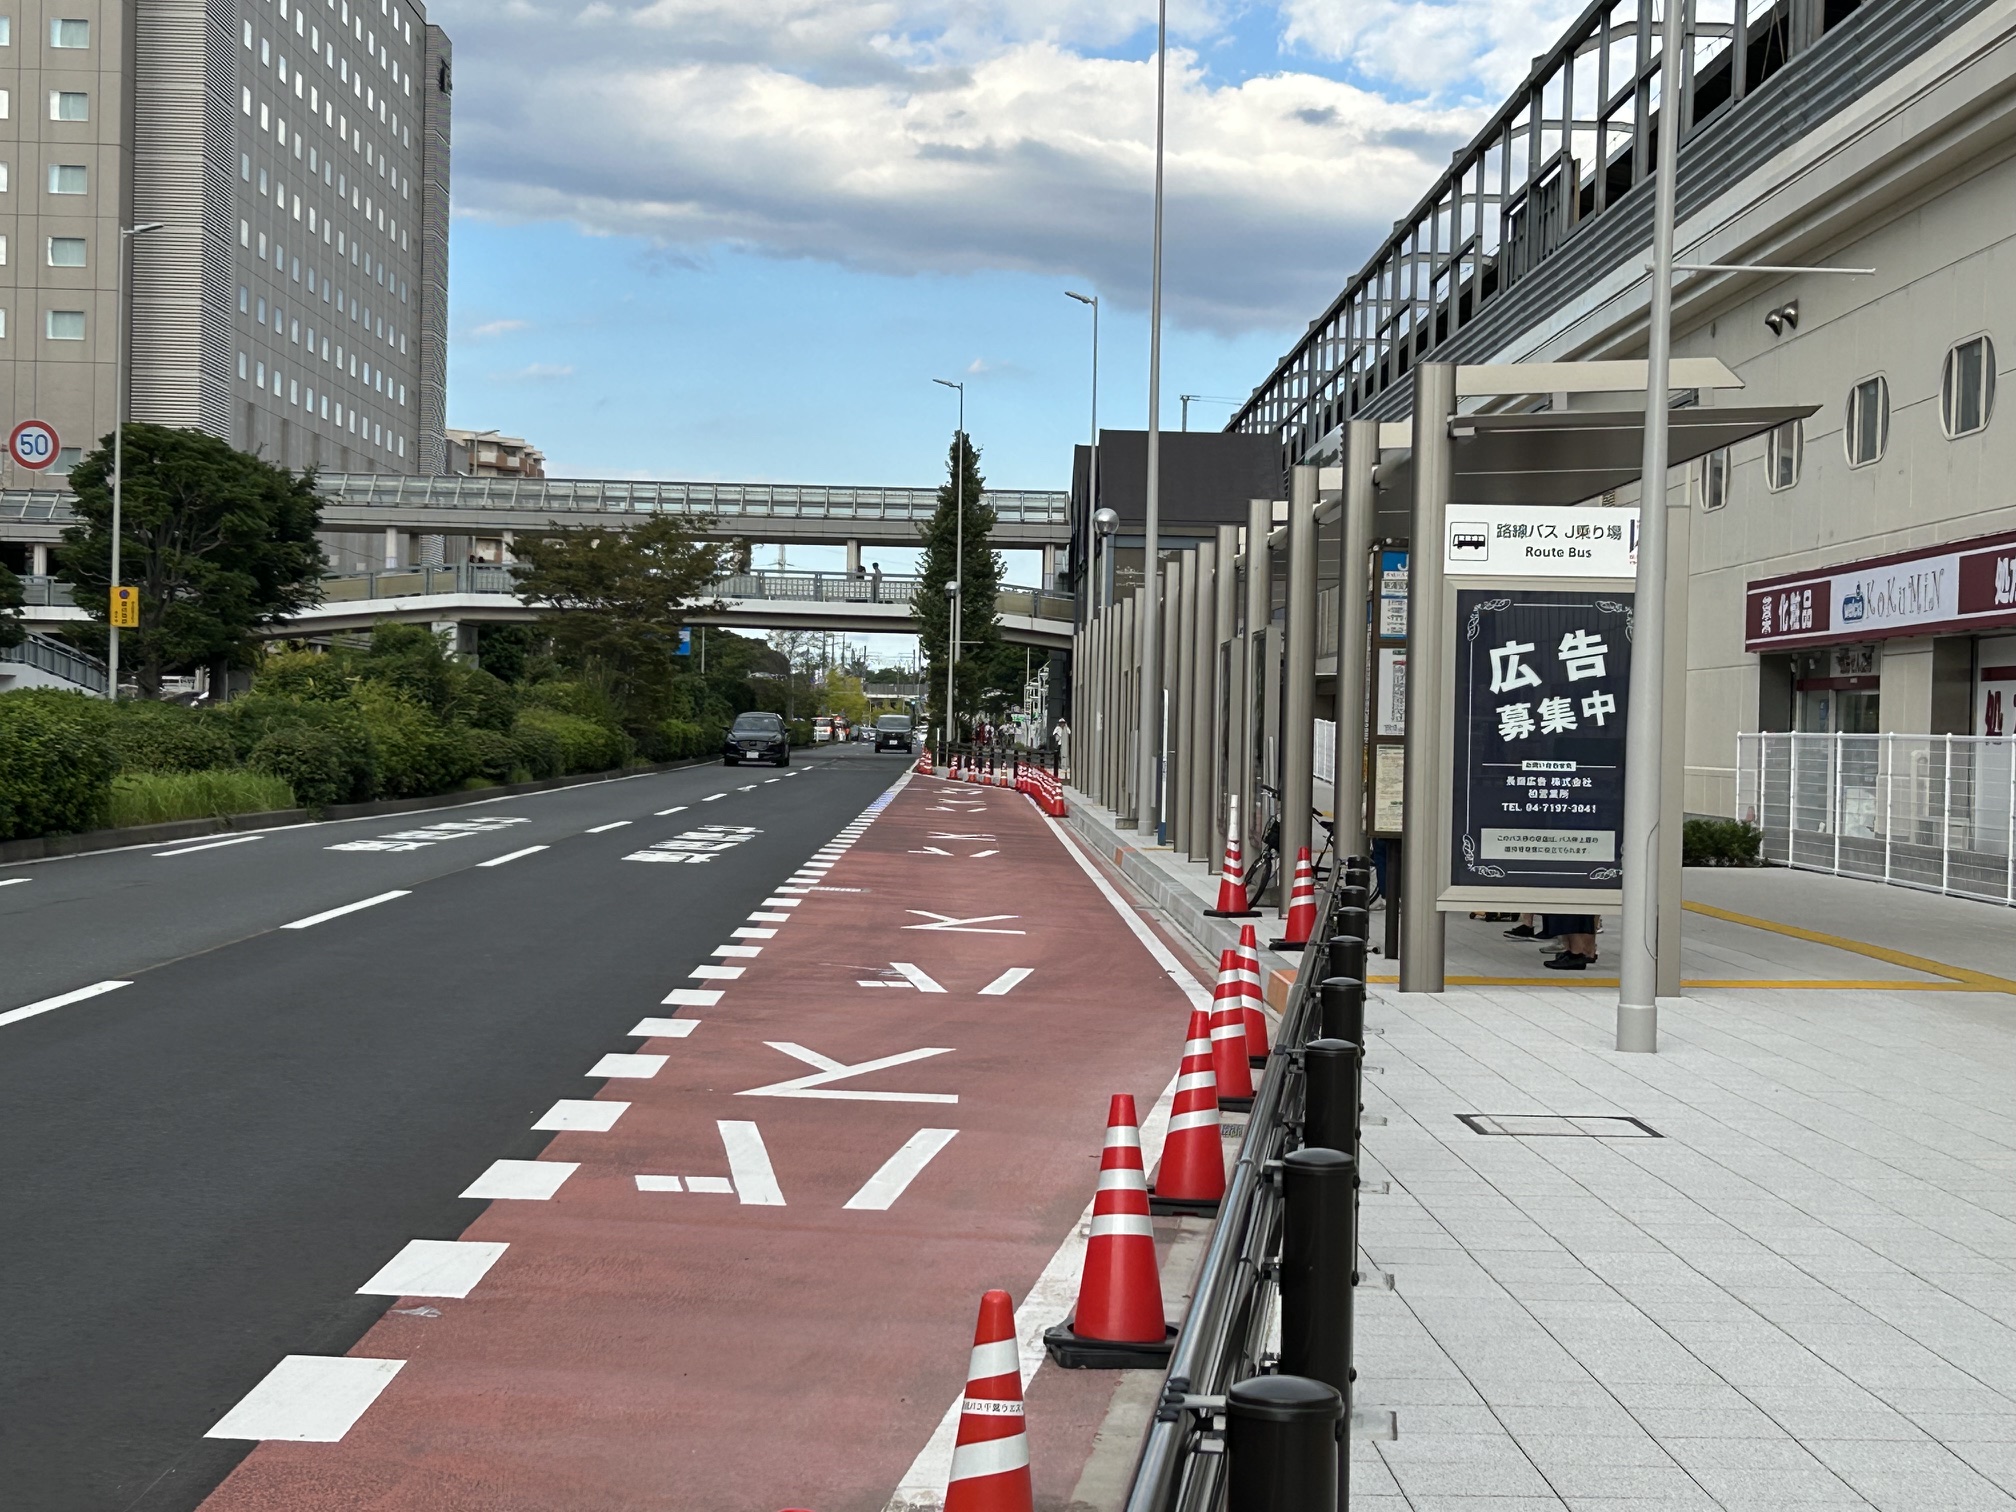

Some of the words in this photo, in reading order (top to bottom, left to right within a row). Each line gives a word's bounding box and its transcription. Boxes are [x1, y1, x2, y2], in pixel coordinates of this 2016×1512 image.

[20, 433, 49, 456] 50
[1496, 523, 1558, 540] 路線バス
[1564, 524, 1622, 541] J乗り場
[1525, 546, 1564, 558] Route
[1568, 547, 1592, 559] Bus
[1489, 628, 1609, 695] 広告
[1495, 689, 1617, 743] 募集中
[1550, 777, 1593, 788] 株式会社
[1525, 802, 1597, 814] 04-7197-3041
[634, 1041, 960, 1212] バス
